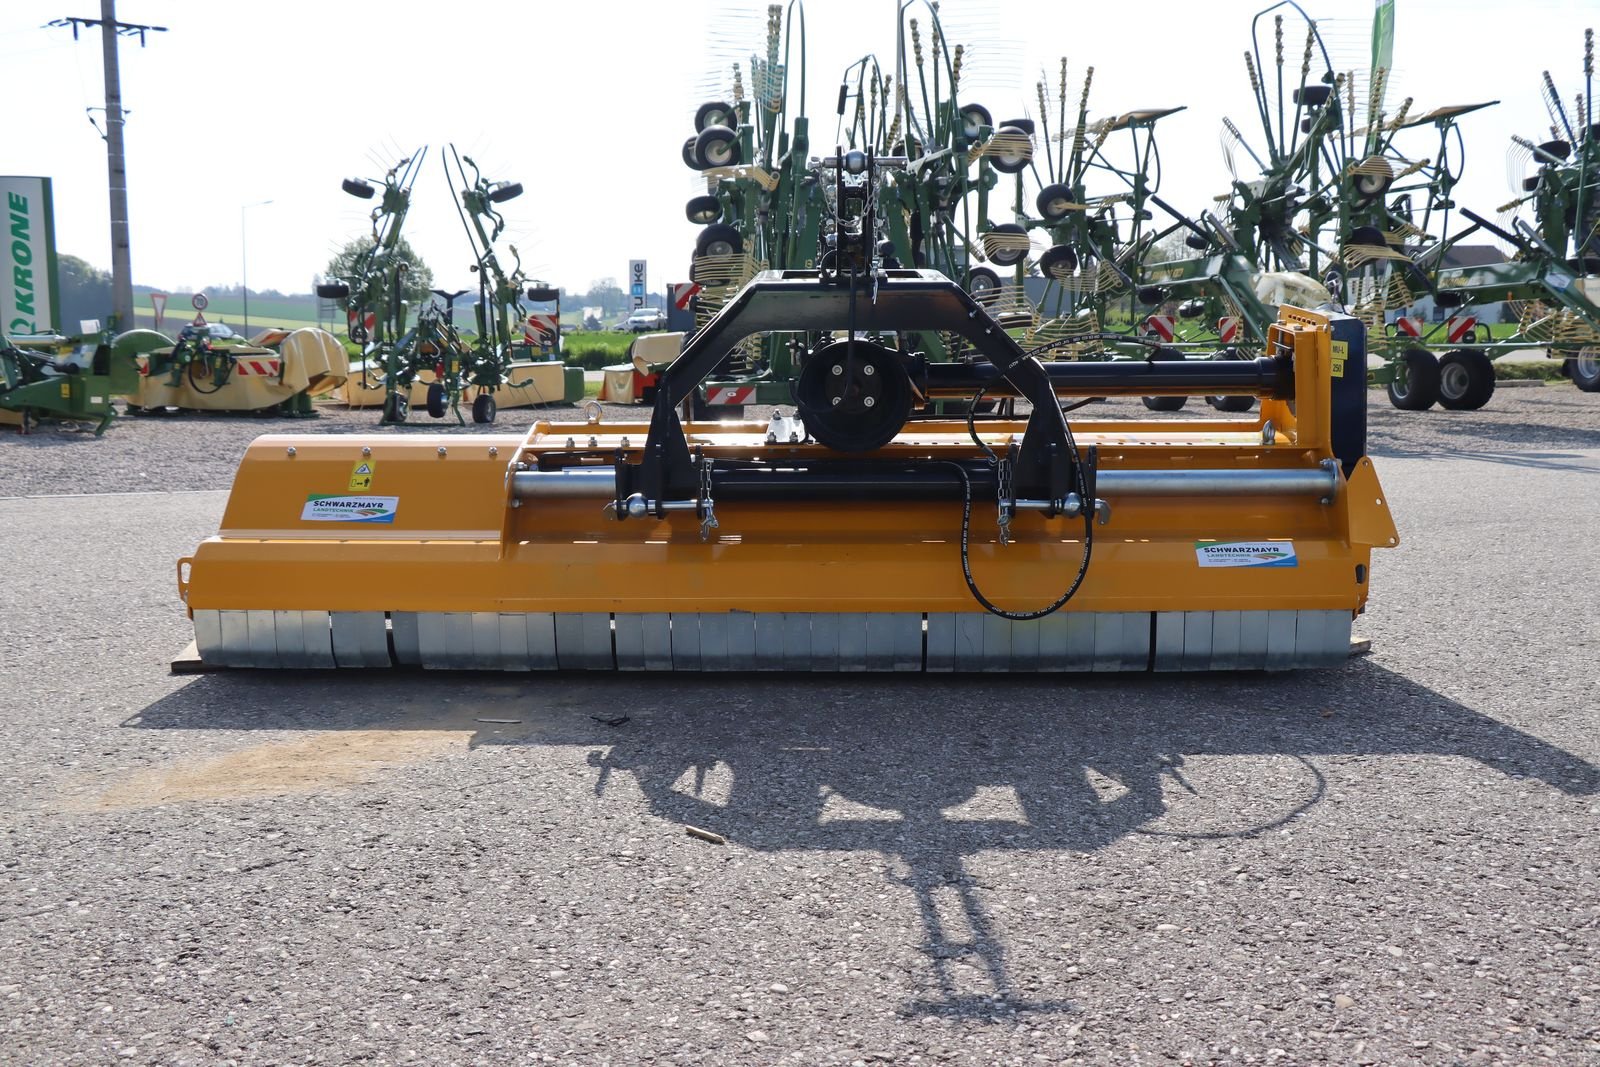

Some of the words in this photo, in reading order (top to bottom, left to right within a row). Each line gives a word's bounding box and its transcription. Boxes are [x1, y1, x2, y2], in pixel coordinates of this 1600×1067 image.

[8, 191, 34, 315] KRONE
[1332, 345, 1345, 354] MU-L
[1332, 364, 1342, 372] 250
[313, 500, 384, 508] SCHWARZMAYR
